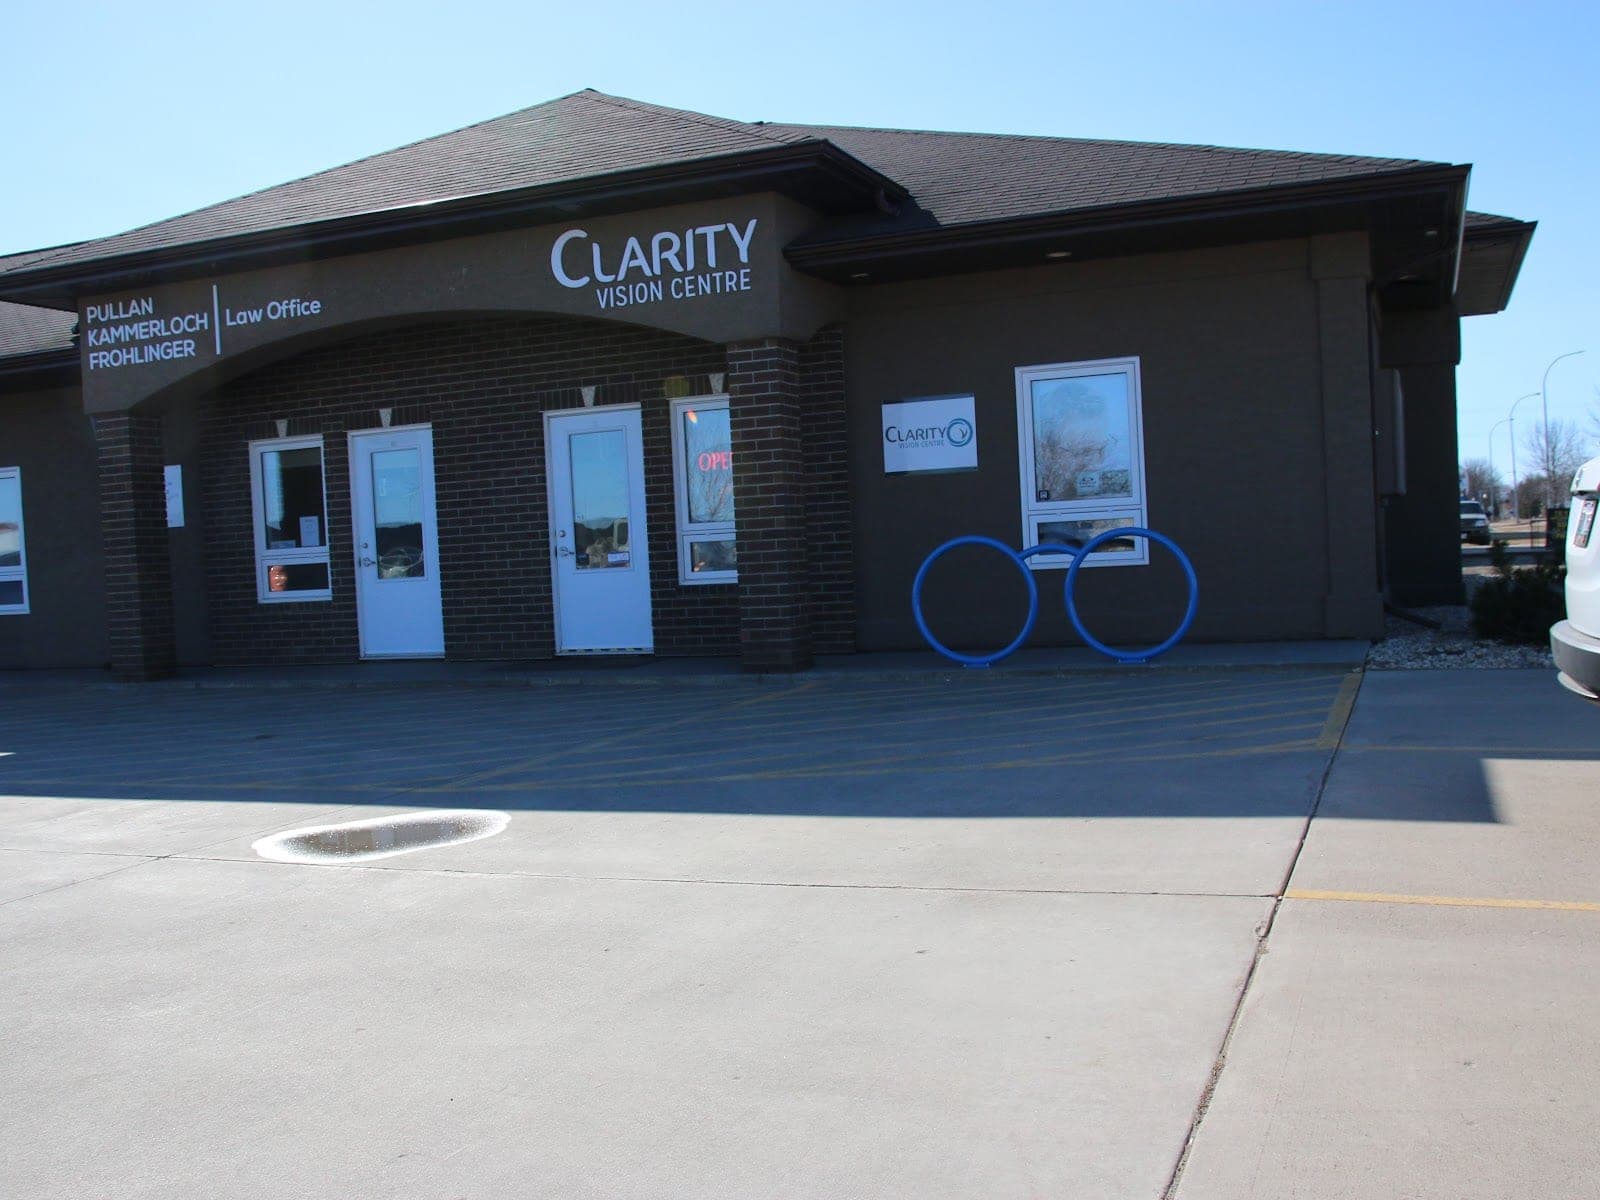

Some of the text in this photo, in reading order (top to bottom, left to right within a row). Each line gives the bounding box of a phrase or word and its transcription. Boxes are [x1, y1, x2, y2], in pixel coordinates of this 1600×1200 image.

[550, 218, 758, 289] CLARITY
[596, 268, 751, 309] VISION CENTRE
[86, 297, 154, 324] PULLAN
[225, 298, 322, 327] Law Office
[87, 312, 209, 347] KAMMERLOCH
[89, 339, 196, 370] FROHLINGER
[885, 426, 947, 443] CLARITY
[698, 451, 733, 472] OPE
